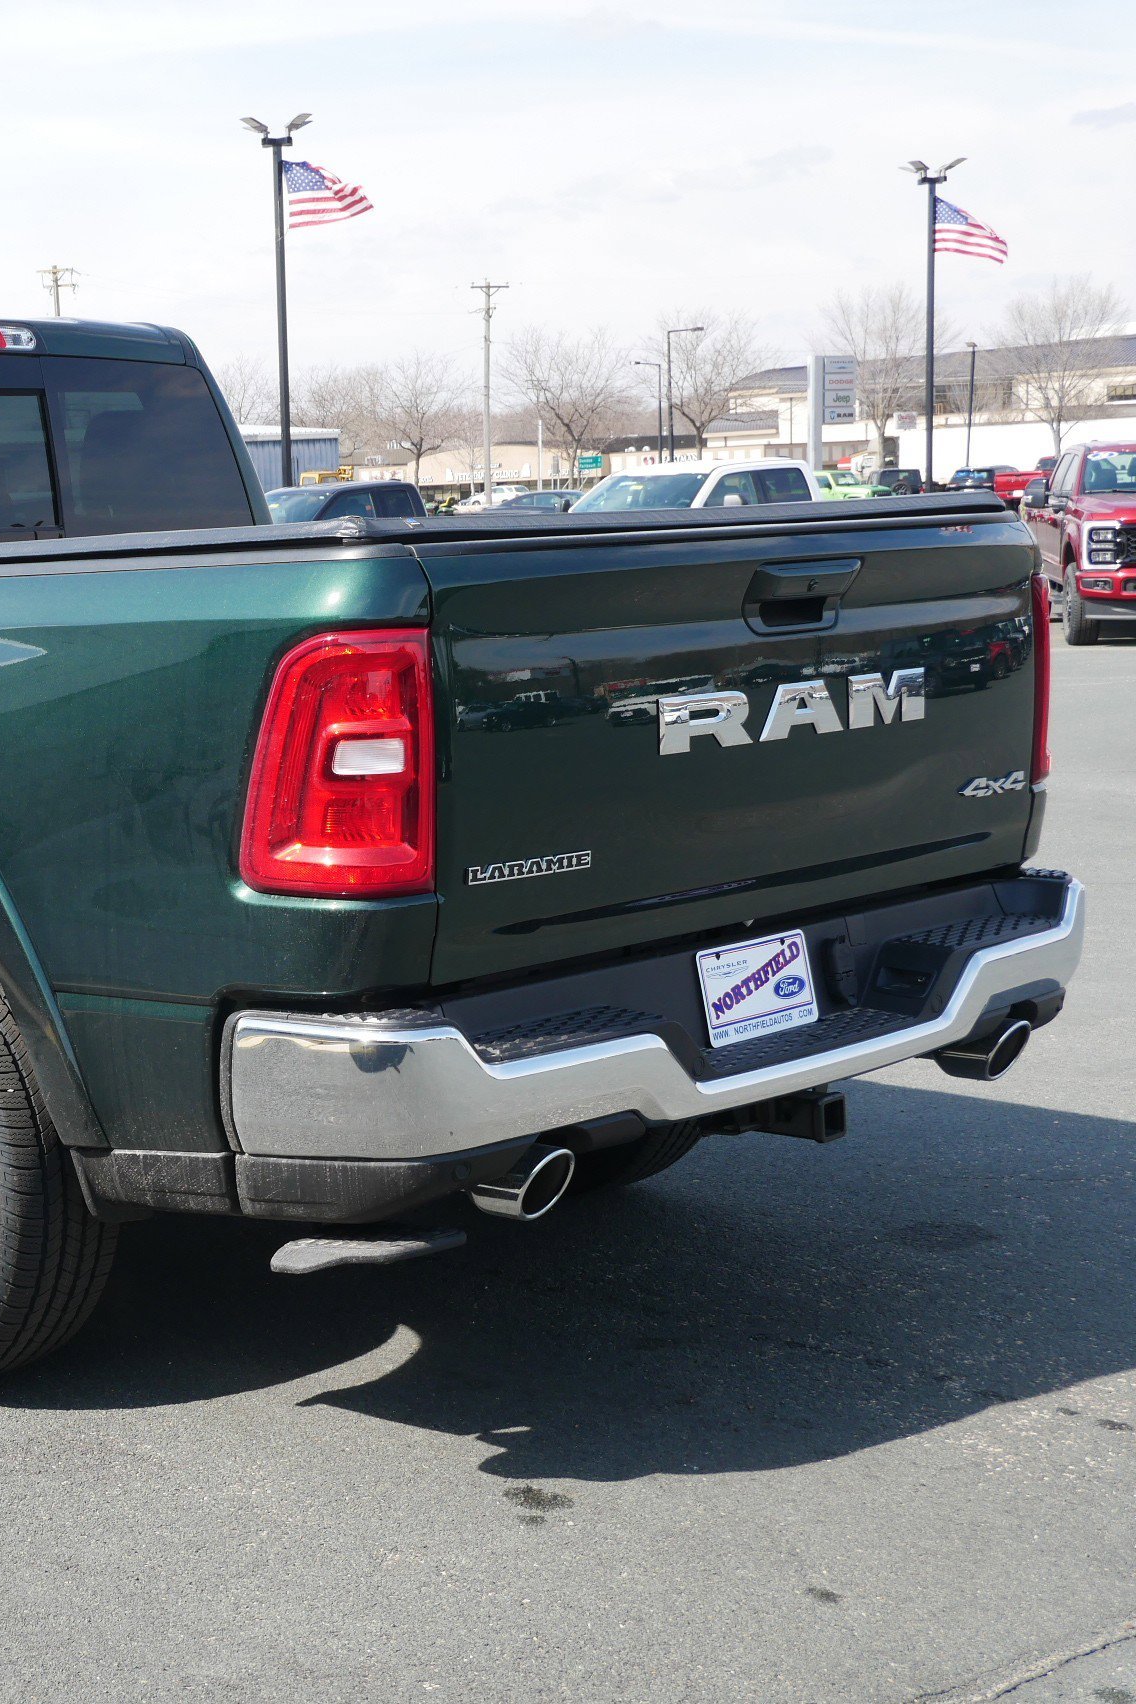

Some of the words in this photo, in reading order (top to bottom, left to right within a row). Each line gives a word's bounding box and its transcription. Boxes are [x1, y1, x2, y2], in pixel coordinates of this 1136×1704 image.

[832, 393, 851, 404] Jeep
[658, 667, 925, 756] RAM
[468, 850, 592, 885] LARAMIE
[705, 959, 748, 973] CHRYSLER
[711, 940, 800, 1020] NORTHFIELD
[778, 978, 800, 995] Ford
